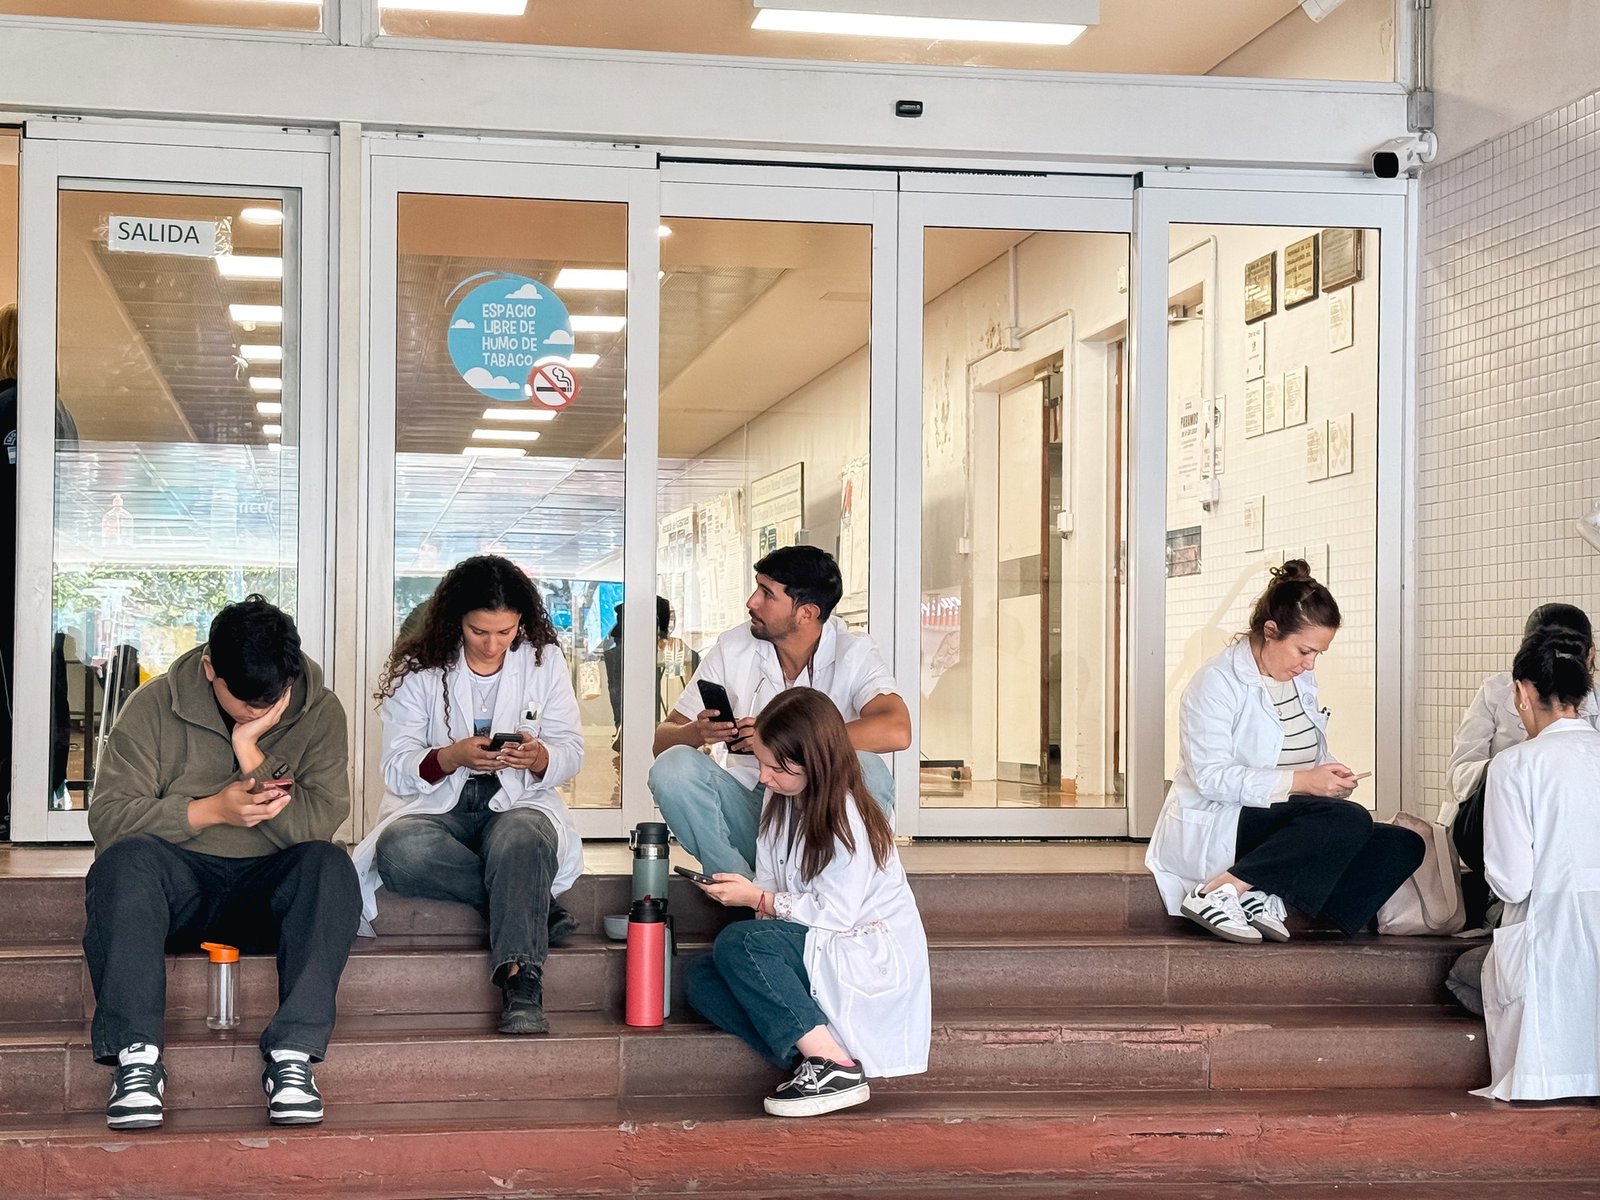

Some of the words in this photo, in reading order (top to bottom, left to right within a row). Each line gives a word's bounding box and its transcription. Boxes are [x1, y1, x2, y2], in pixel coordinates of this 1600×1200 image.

[118, 222, 200, 244] SALIDA
[482, 303, 537, 318] ESPACIO
[484, 320, 517, 335] LIBRE
[520, 320, 536, 335] DE
[482, 336, 519, 351] HUMO
[521, 337, 538, 352] DE
[482, 353, 533, 367] TABACO
